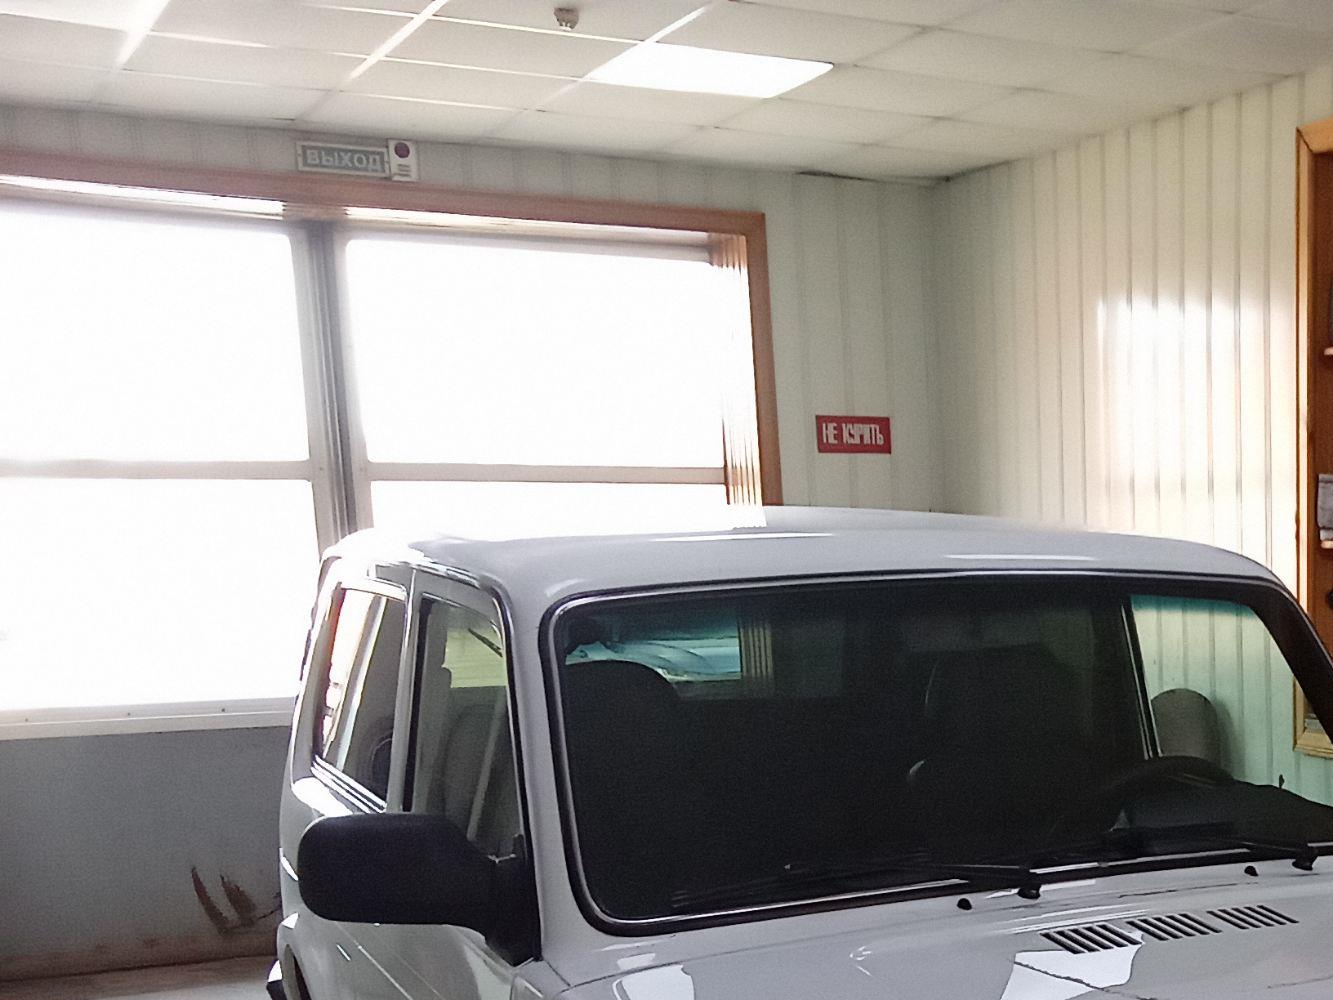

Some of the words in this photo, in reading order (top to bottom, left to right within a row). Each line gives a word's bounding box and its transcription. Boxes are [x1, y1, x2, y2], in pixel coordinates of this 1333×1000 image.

[306, 149, 382, 172] ВЫХОД
[822, 422, 838, 445] НЕ
[842, 423, 885, 446] КУРИТЬ
